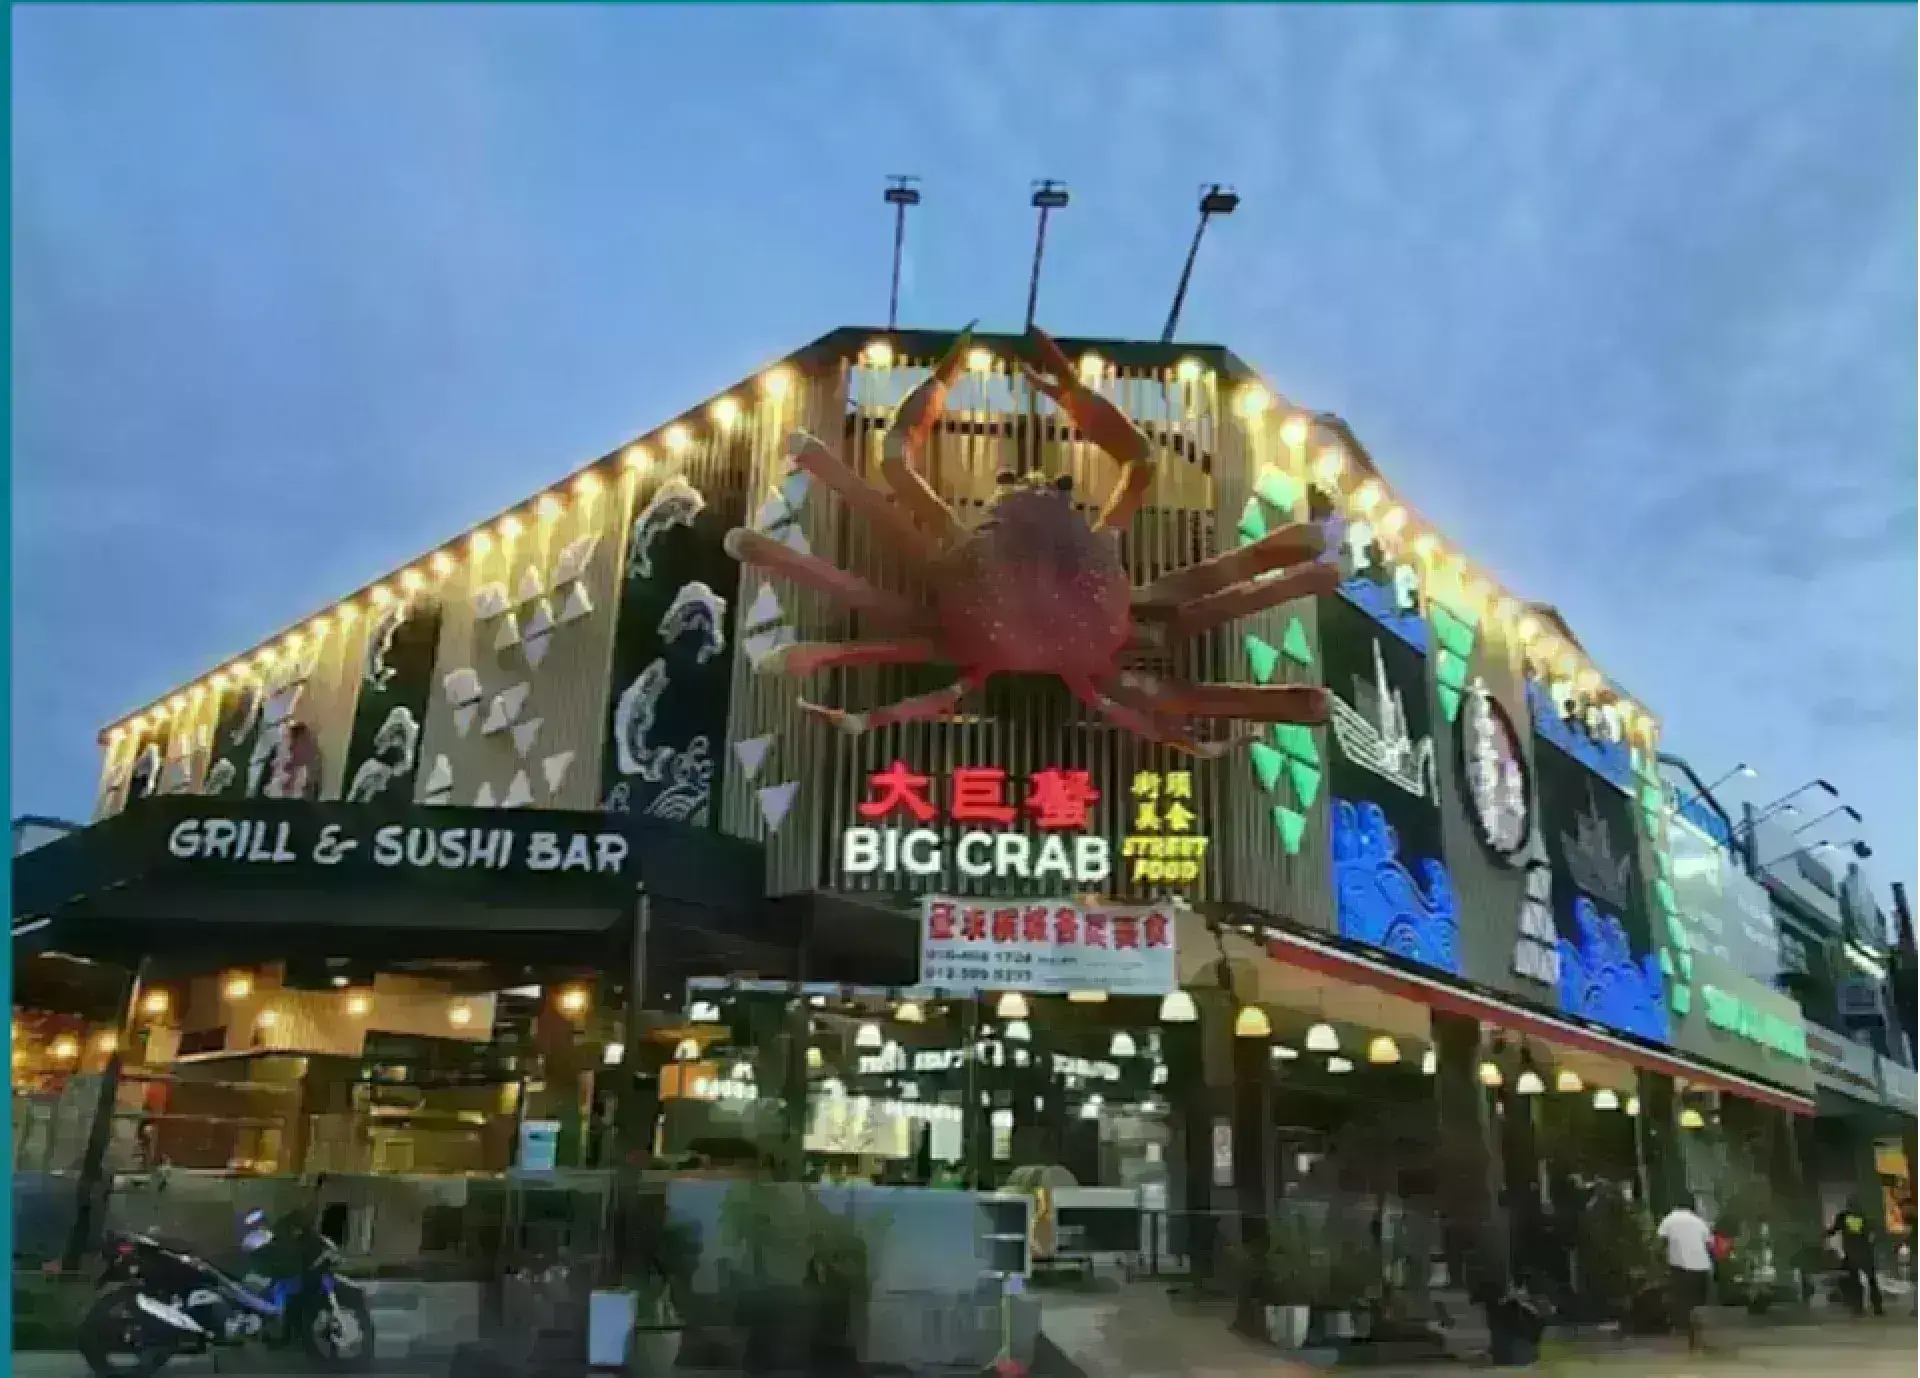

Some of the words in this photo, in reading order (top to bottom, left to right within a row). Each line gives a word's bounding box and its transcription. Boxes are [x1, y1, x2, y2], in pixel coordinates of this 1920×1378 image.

[168, 819, 297, 864] GRILL
[313, 824, 358, 866] &
[373, 824, 514, 870] SUSHI
[526, 831, 630, 874] BAR
[843, 827, 941, 875] BIG
[956, 830, 1111, 883] CRAB
[1122, 836, 1209, 857] STREET
[1131, 859, 1198, 882] FOOD
